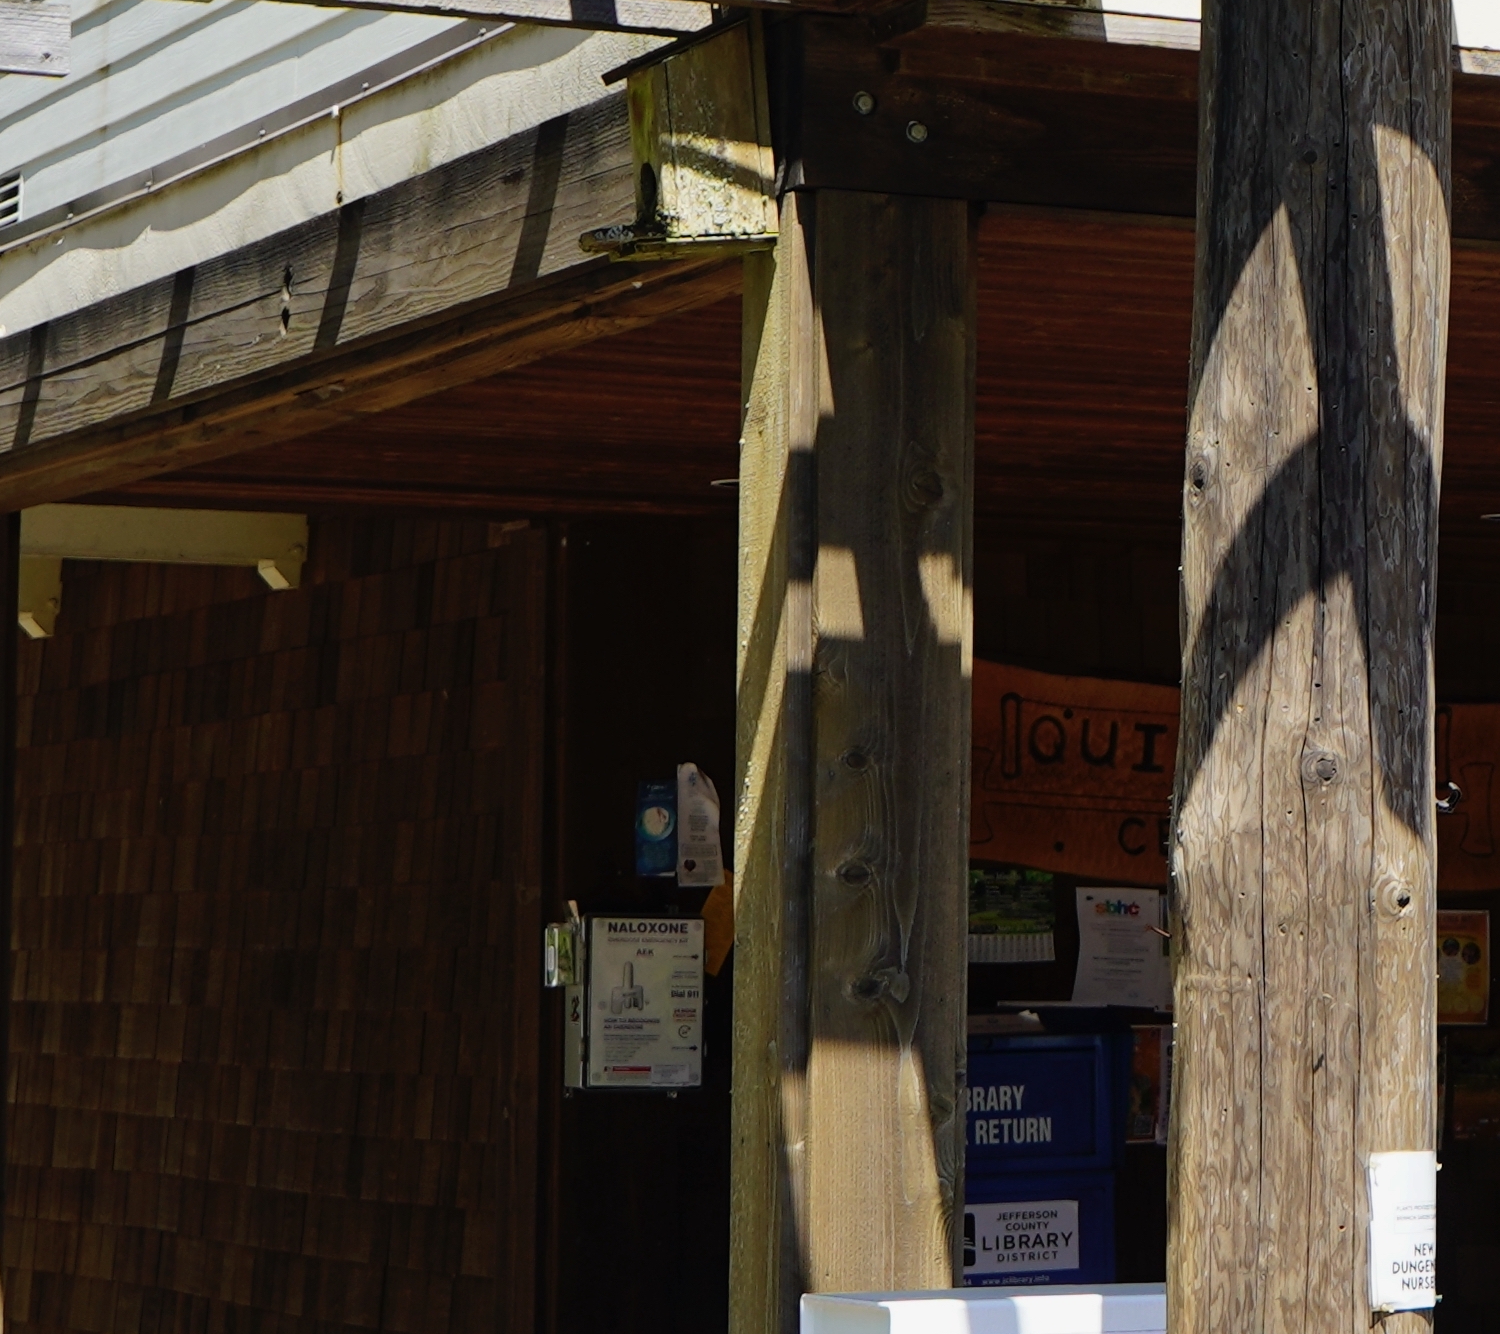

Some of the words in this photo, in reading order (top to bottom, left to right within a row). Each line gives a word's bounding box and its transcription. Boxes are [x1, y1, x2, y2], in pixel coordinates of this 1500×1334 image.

[608, 922, 688, 934] NALOXONE
[636, 948, 654, 957] AEK
[671, 989, 685, 999] Dial
[687, 989, 699, 998] 911
[975, 1117, 1052, 1145] RETURN
[997, 1210, 1058, 1221] JEFFERSON
[1005, 1221, 1049, 1231] COUNTY
[982, 1231, 1073, 1251] LIBRARY
[997, 1250, 1058, 1262] DISTRICT
